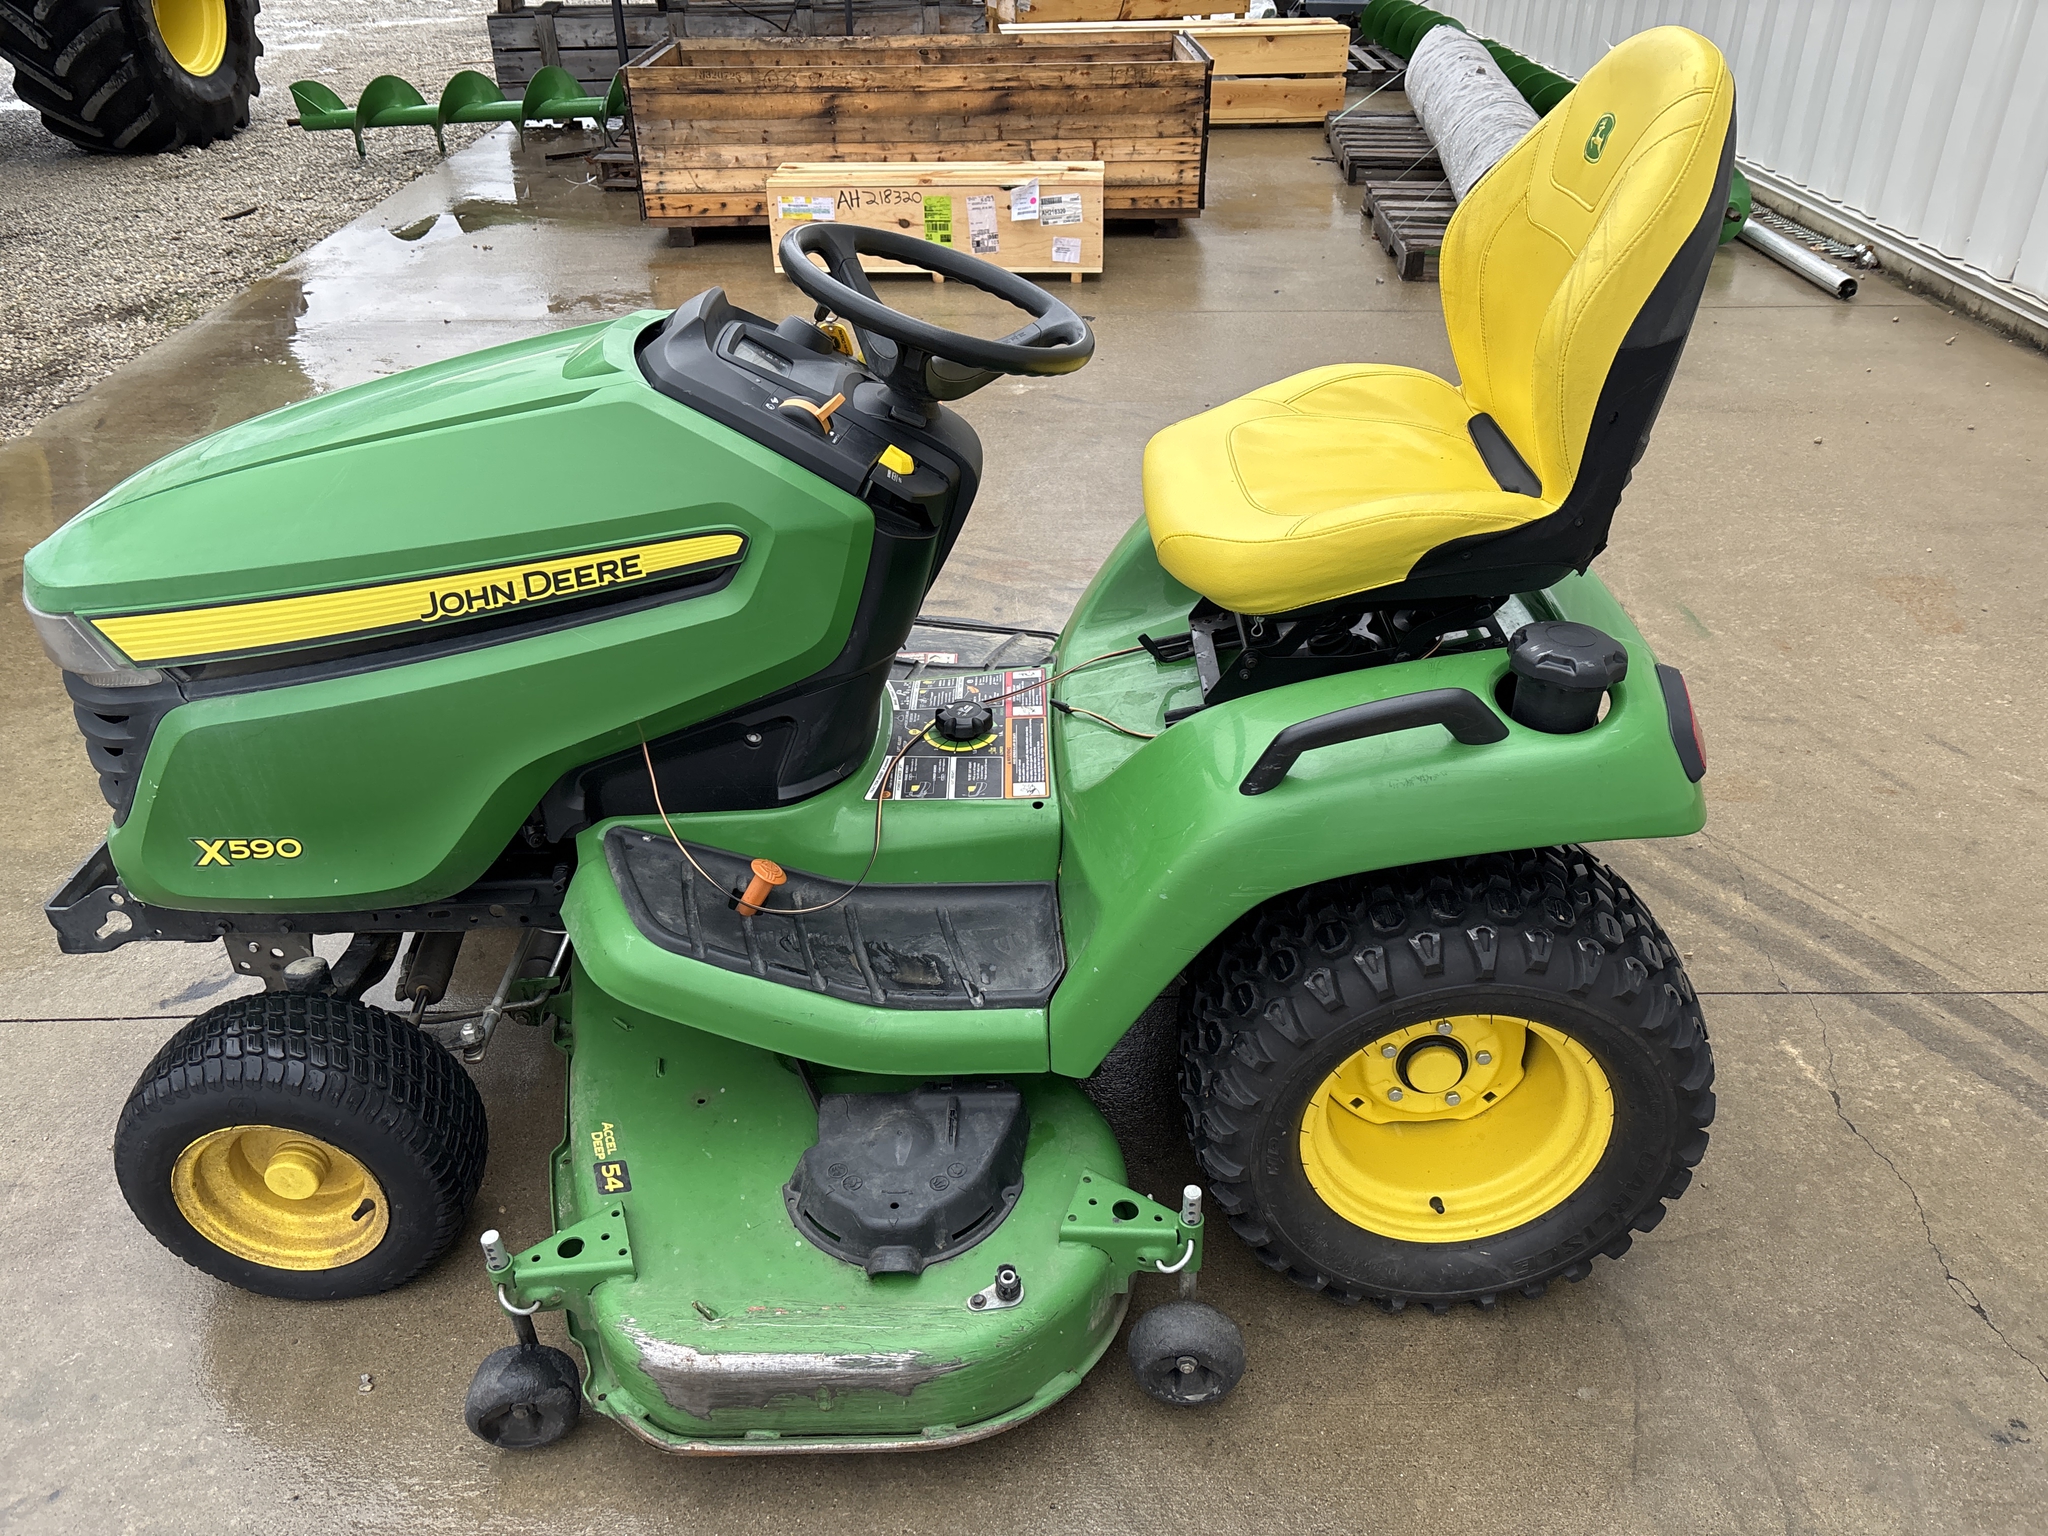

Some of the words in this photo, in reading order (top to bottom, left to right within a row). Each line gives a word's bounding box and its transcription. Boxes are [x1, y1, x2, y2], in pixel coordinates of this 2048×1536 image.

[421, 581, 516, 620] JOHN
[523, 554, 643, 598] DEERE
[193, 838, 303, 867] X590
[591, 1131, 606, 1160] DEEP
[601, 1122, 617, 1155] ACCEL
[601, 1163, 624, 1192] 54
[1513, 1151, 1657, 1277] CARLISLE
